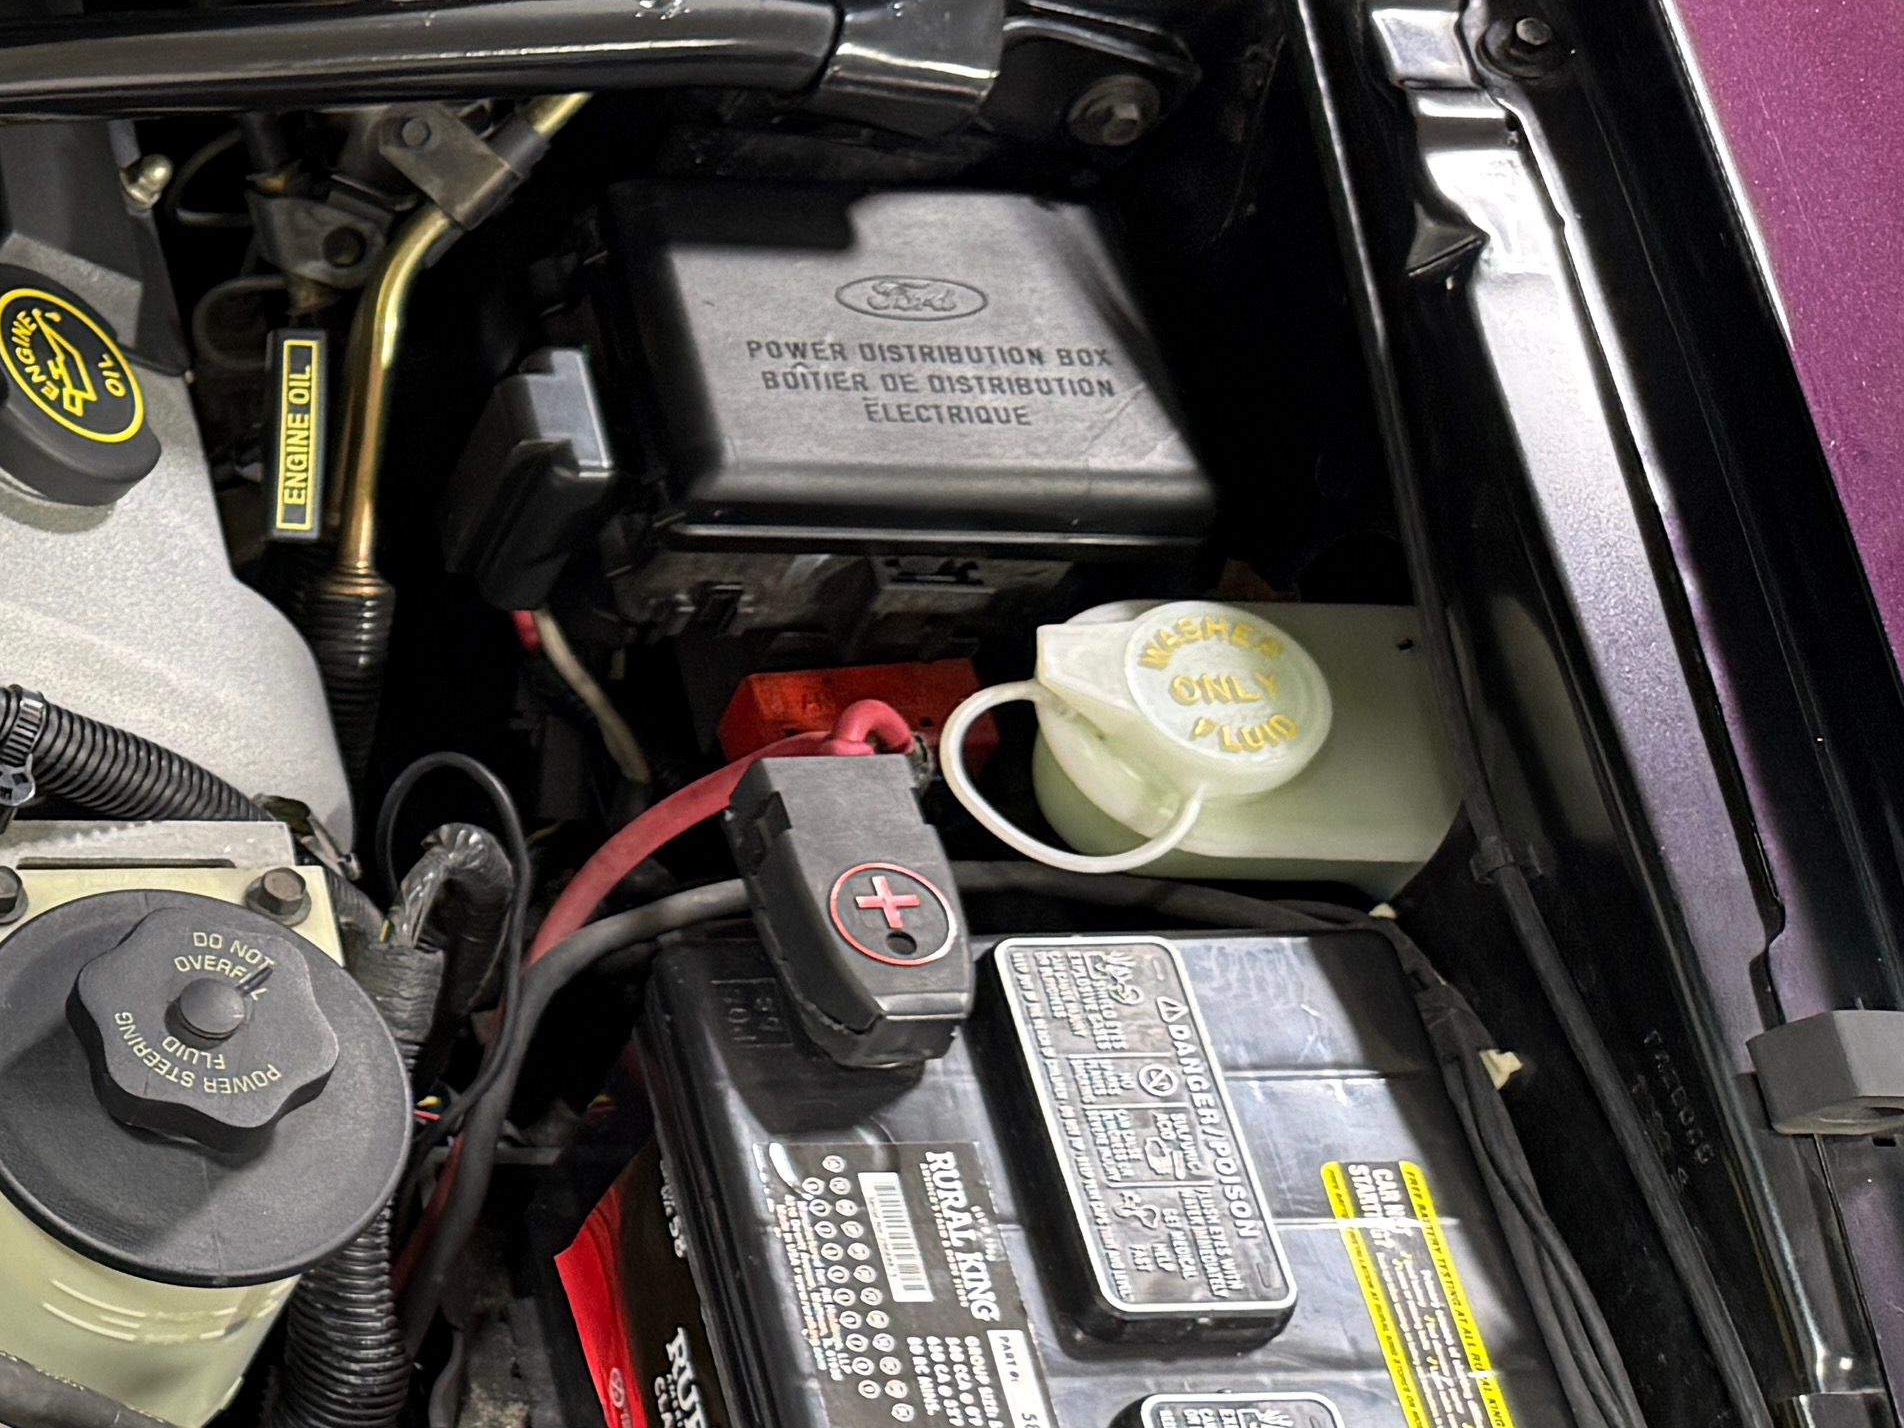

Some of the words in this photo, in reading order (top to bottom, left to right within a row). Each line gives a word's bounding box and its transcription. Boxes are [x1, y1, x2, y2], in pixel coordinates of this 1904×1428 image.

[11, 310, 61, 401] ENGINE
[97, 353, 127, 397] OIL
[746, 339, 848, 363] POWER
[858, 342, 1045, 367] DISTRIBUTION
[1054, 347, 1114, 368] BOX
[288, 364, 312, 405] OIL
[761, 362, 869, 392] BOÎTIER
[879, 371, 920, 394] DE
[927, 373, 1116, 398] DISTRIBUTION
[861, 395, 1033, 427] ÉLECTRIQUE
[283, 413, 310, 505] ENGINE
[1168, 672, 1279, 706] ONLY
[192, 931, 223, 950] DO
[229, 939, 276, 970] NOT
[174, 955, 268, 1001] OVERFIL
[114, 1010, 197, 1089] STEERING
[161, 1035, 227, 1070] FLUID
[203, 1063, 283, 1095] POWER
[1166, 1023, 1262, 1240] DANGER/POISON
[924, 1150, 978, 1248] RURAL
[955, 1250, 1001, 1323] KING
[998, 1335, 1020, 1367] PART
